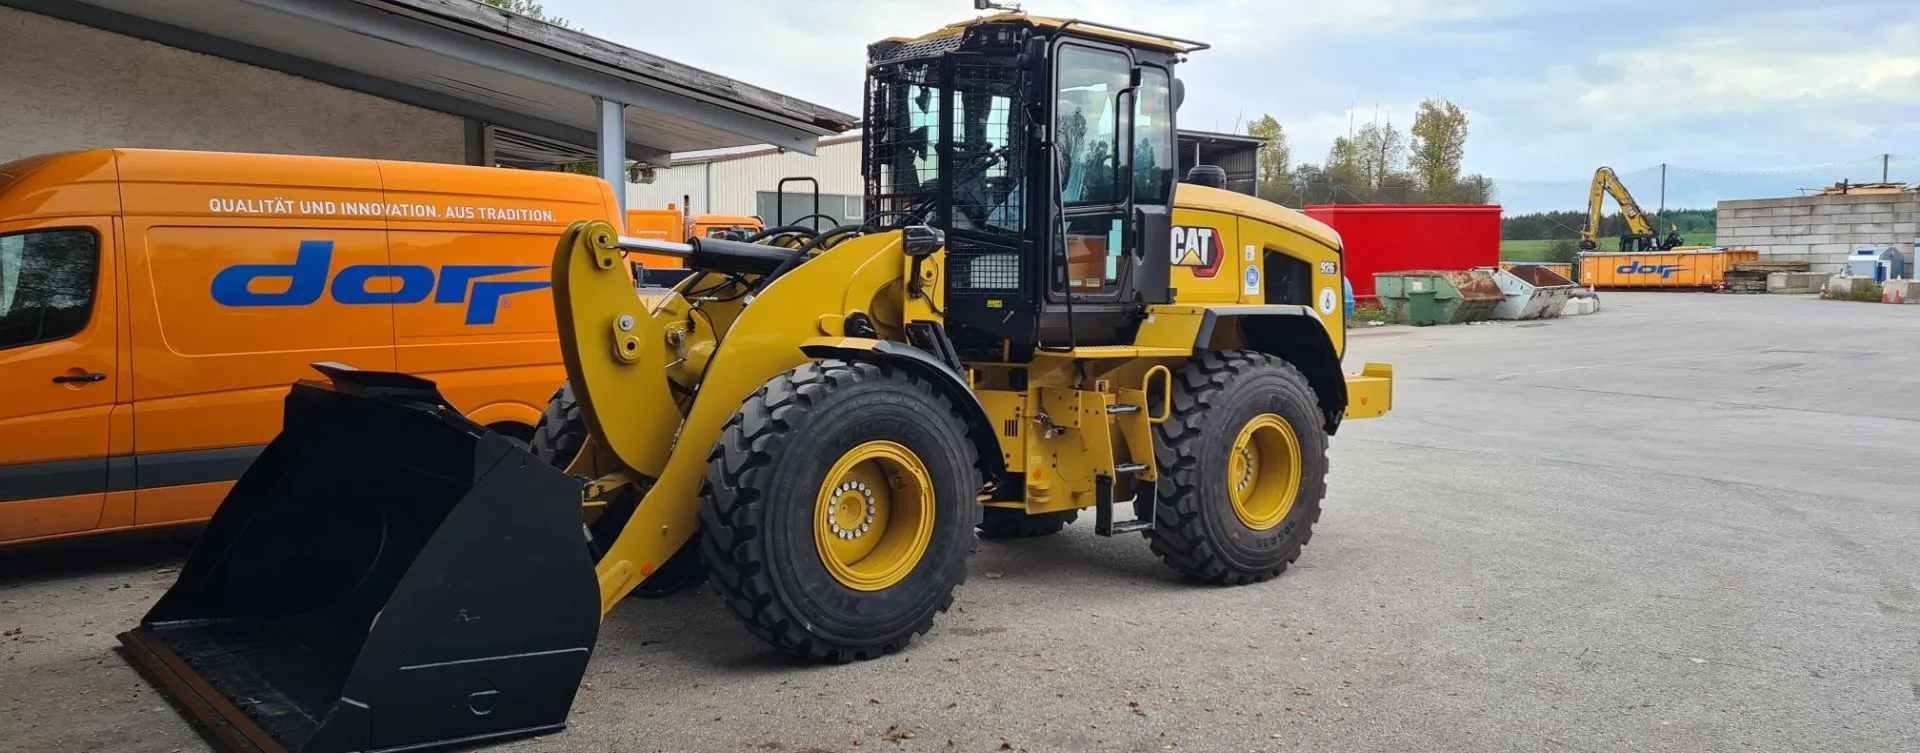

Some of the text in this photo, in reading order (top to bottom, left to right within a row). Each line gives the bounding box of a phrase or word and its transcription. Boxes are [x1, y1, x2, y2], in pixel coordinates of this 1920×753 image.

[209, 197, 557, 222] QUALITÄT UND INNOVATION. AUS TRADITION.
[1171, 226, 1212, 266] CAT
[1320, 261, 1335, 274] 926
[1325, 292, 1331, 309] 6
